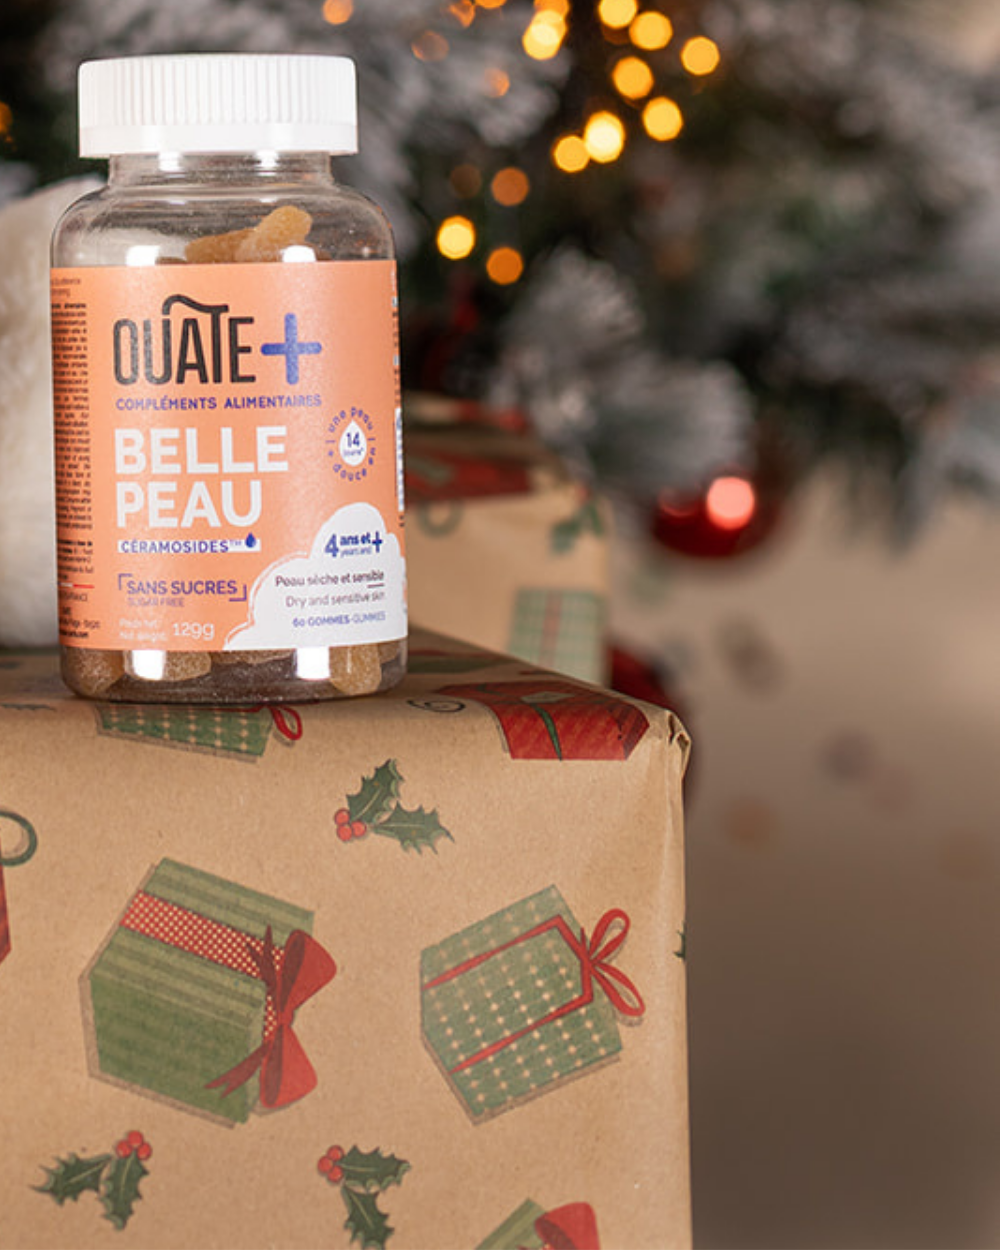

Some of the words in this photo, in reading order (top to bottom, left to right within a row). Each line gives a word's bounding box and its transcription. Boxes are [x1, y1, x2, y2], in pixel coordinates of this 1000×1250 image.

[116, 394, 217, 411] COMPLÉMENTS
[224, 394, 322, 409] ALIMENTAIRES
[346, 432, 361, 448] 14
[115, 426, 289, 475] BELLE
[116, 481, 263, 528] PEAU
[324, 533, 340, 558] 4
[340, 535, 360, 546] ans
[360, 532, 372, 545] et
[275, 575, 305, 587] Peau
[307, 573, 339, 586] sèche
[341, 572, 352, 584] et
[353, 569, 385, 583] sensible
[126, 580, 168, 595] SANS
[171, 580, 238, 595] SUCRES
[285, 595, 307, 609] Dry
[308, 594, 330, 606] and
[172, 621, 215, 641] 129g
